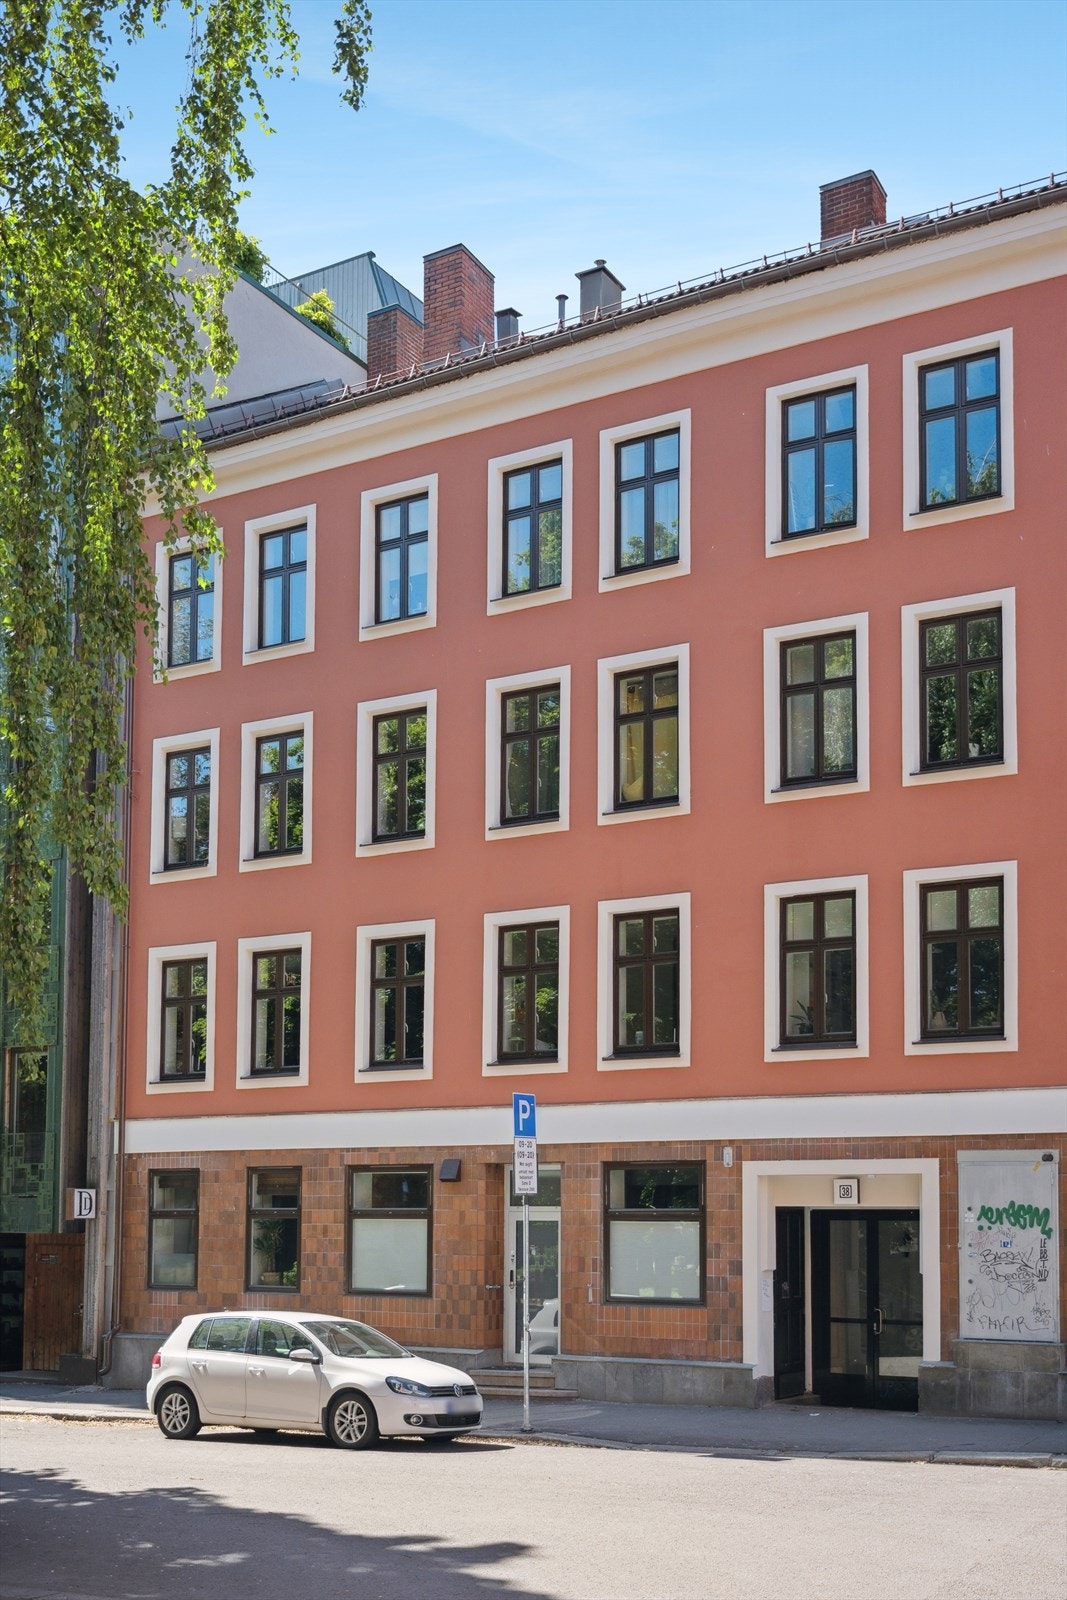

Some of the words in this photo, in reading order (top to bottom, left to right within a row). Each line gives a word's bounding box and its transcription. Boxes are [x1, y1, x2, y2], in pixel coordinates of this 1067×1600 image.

[519, 1100, 530, 1130] P
[517, 1151, 534, 1159] (09-20)
[842, 1187, 850, 1196] 38
